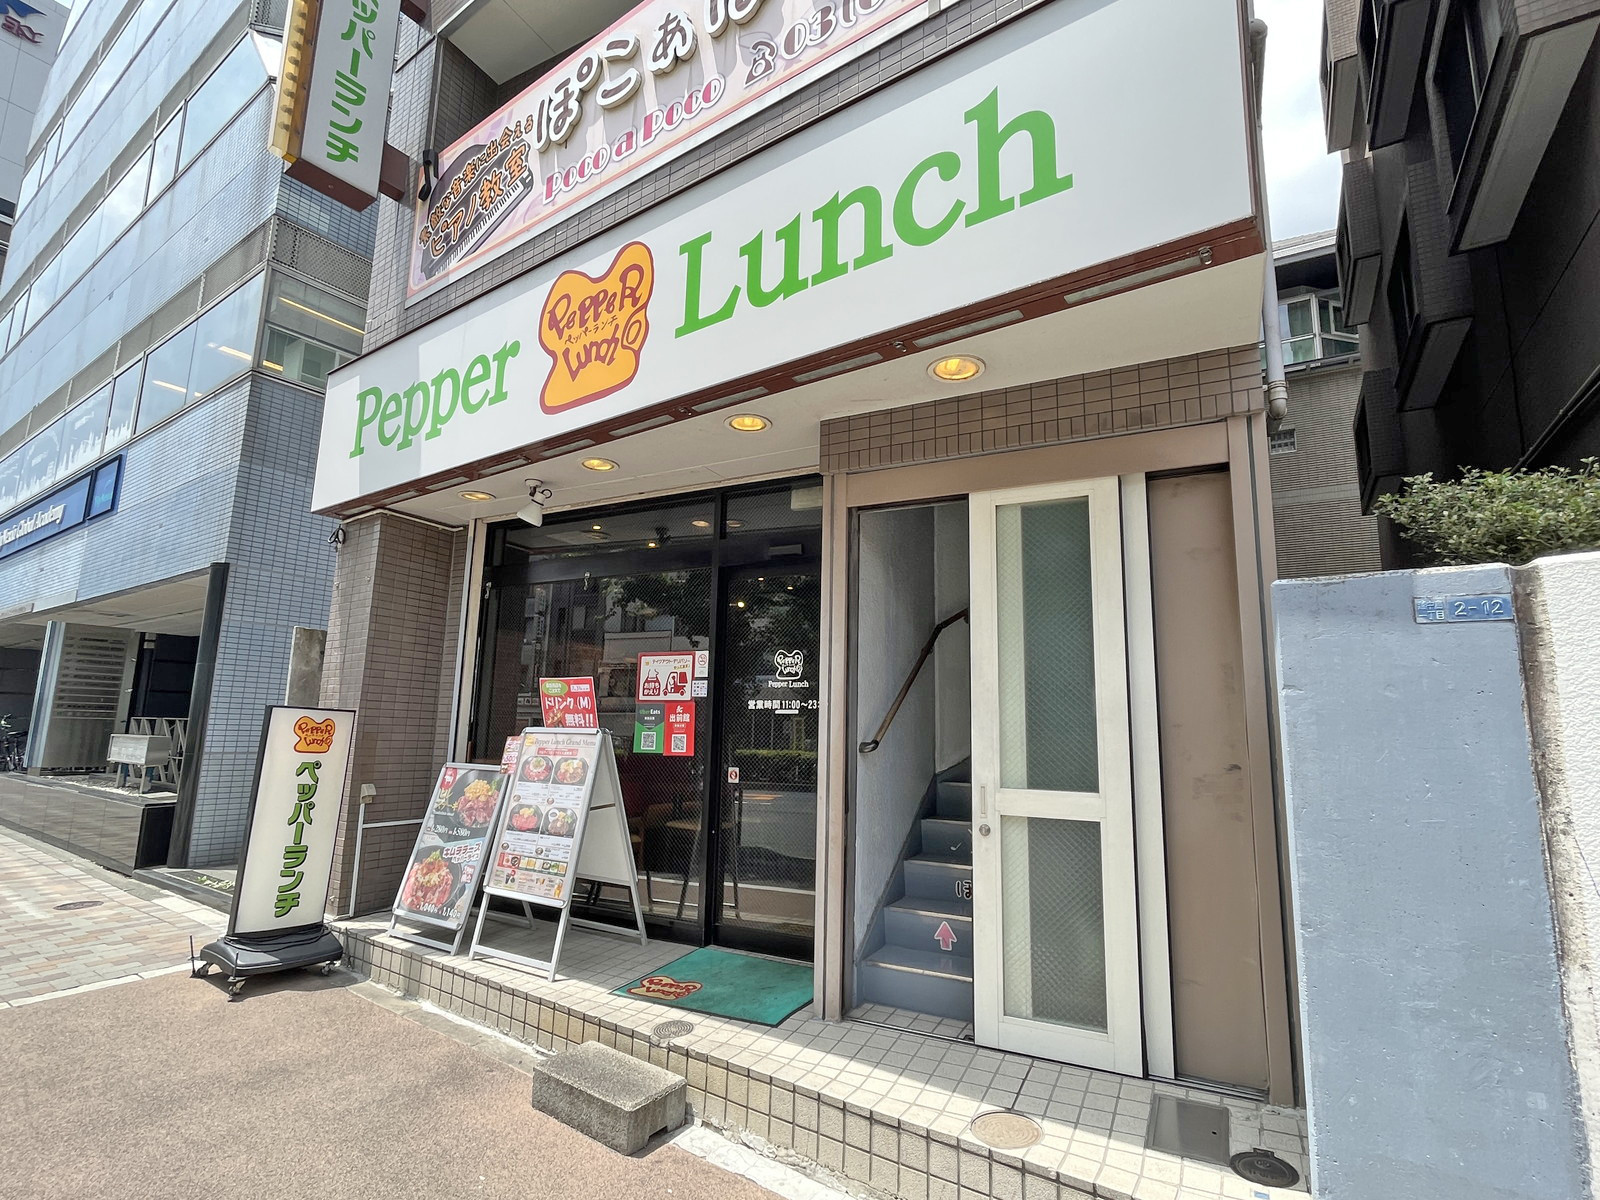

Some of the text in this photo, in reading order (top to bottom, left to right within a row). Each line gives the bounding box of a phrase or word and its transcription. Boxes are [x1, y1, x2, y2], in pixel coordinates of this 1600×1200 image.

[614, 128, 640, 159] a
[418, 114, 534, 248] 素敵な音楽に出会える
[430, 143, 528, 257] ピアノ教室
[674, 86, 1073, 339] Lunch
[564, 315, 619, 345] ペッパーランチ
[349, 337, 520, 458] Pepper
[1454, 599, 1504, 616] 2-12
[768, 680, 809, 688] Pepper Lunch
[669, 713, 690, 722] 出前館
[748, 699, 780, 710] 営業時間
[274, 760, 322, 918] ペッパーランチ
